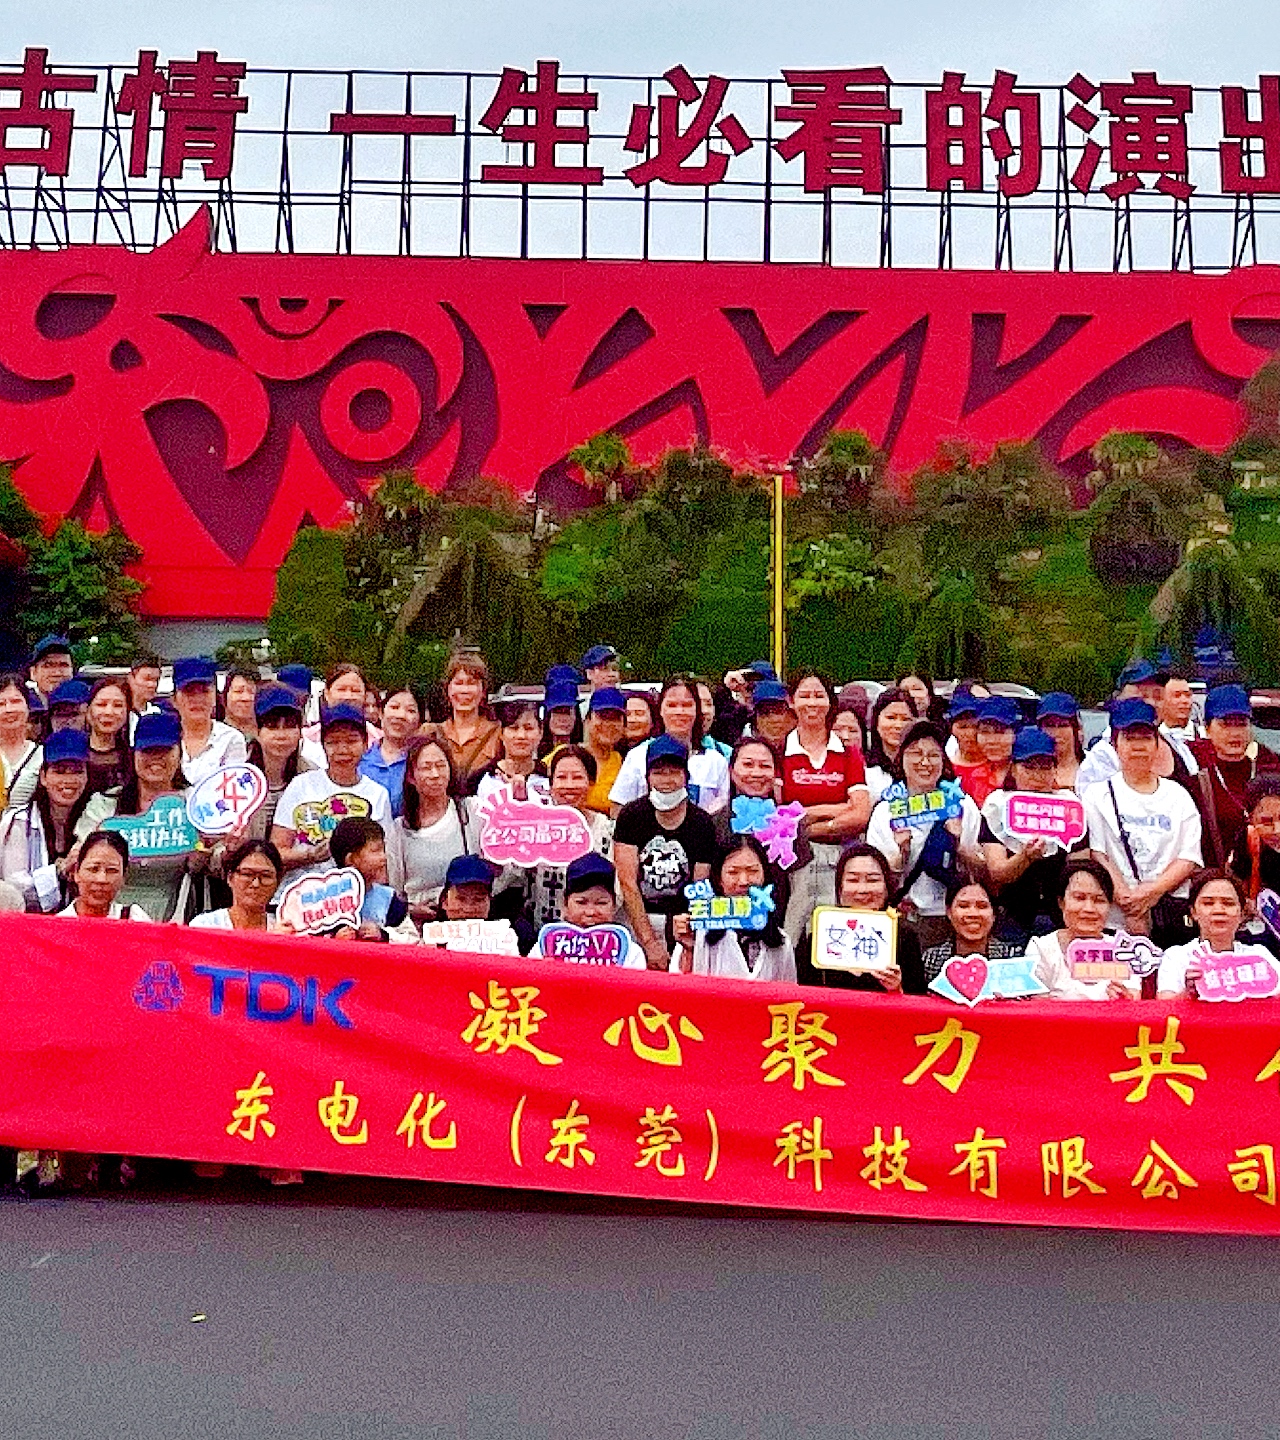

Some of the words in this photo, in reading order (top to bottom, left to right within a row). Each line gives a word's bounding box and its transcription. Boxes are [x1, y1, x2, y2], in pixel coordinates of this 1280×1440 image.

[683, 878, 715, 899] GO!
[825, 924, 880, 960] 女神
[192, 964, 358, 1029] TDK
[461, 979, 981, 1094] 凝心聚力
